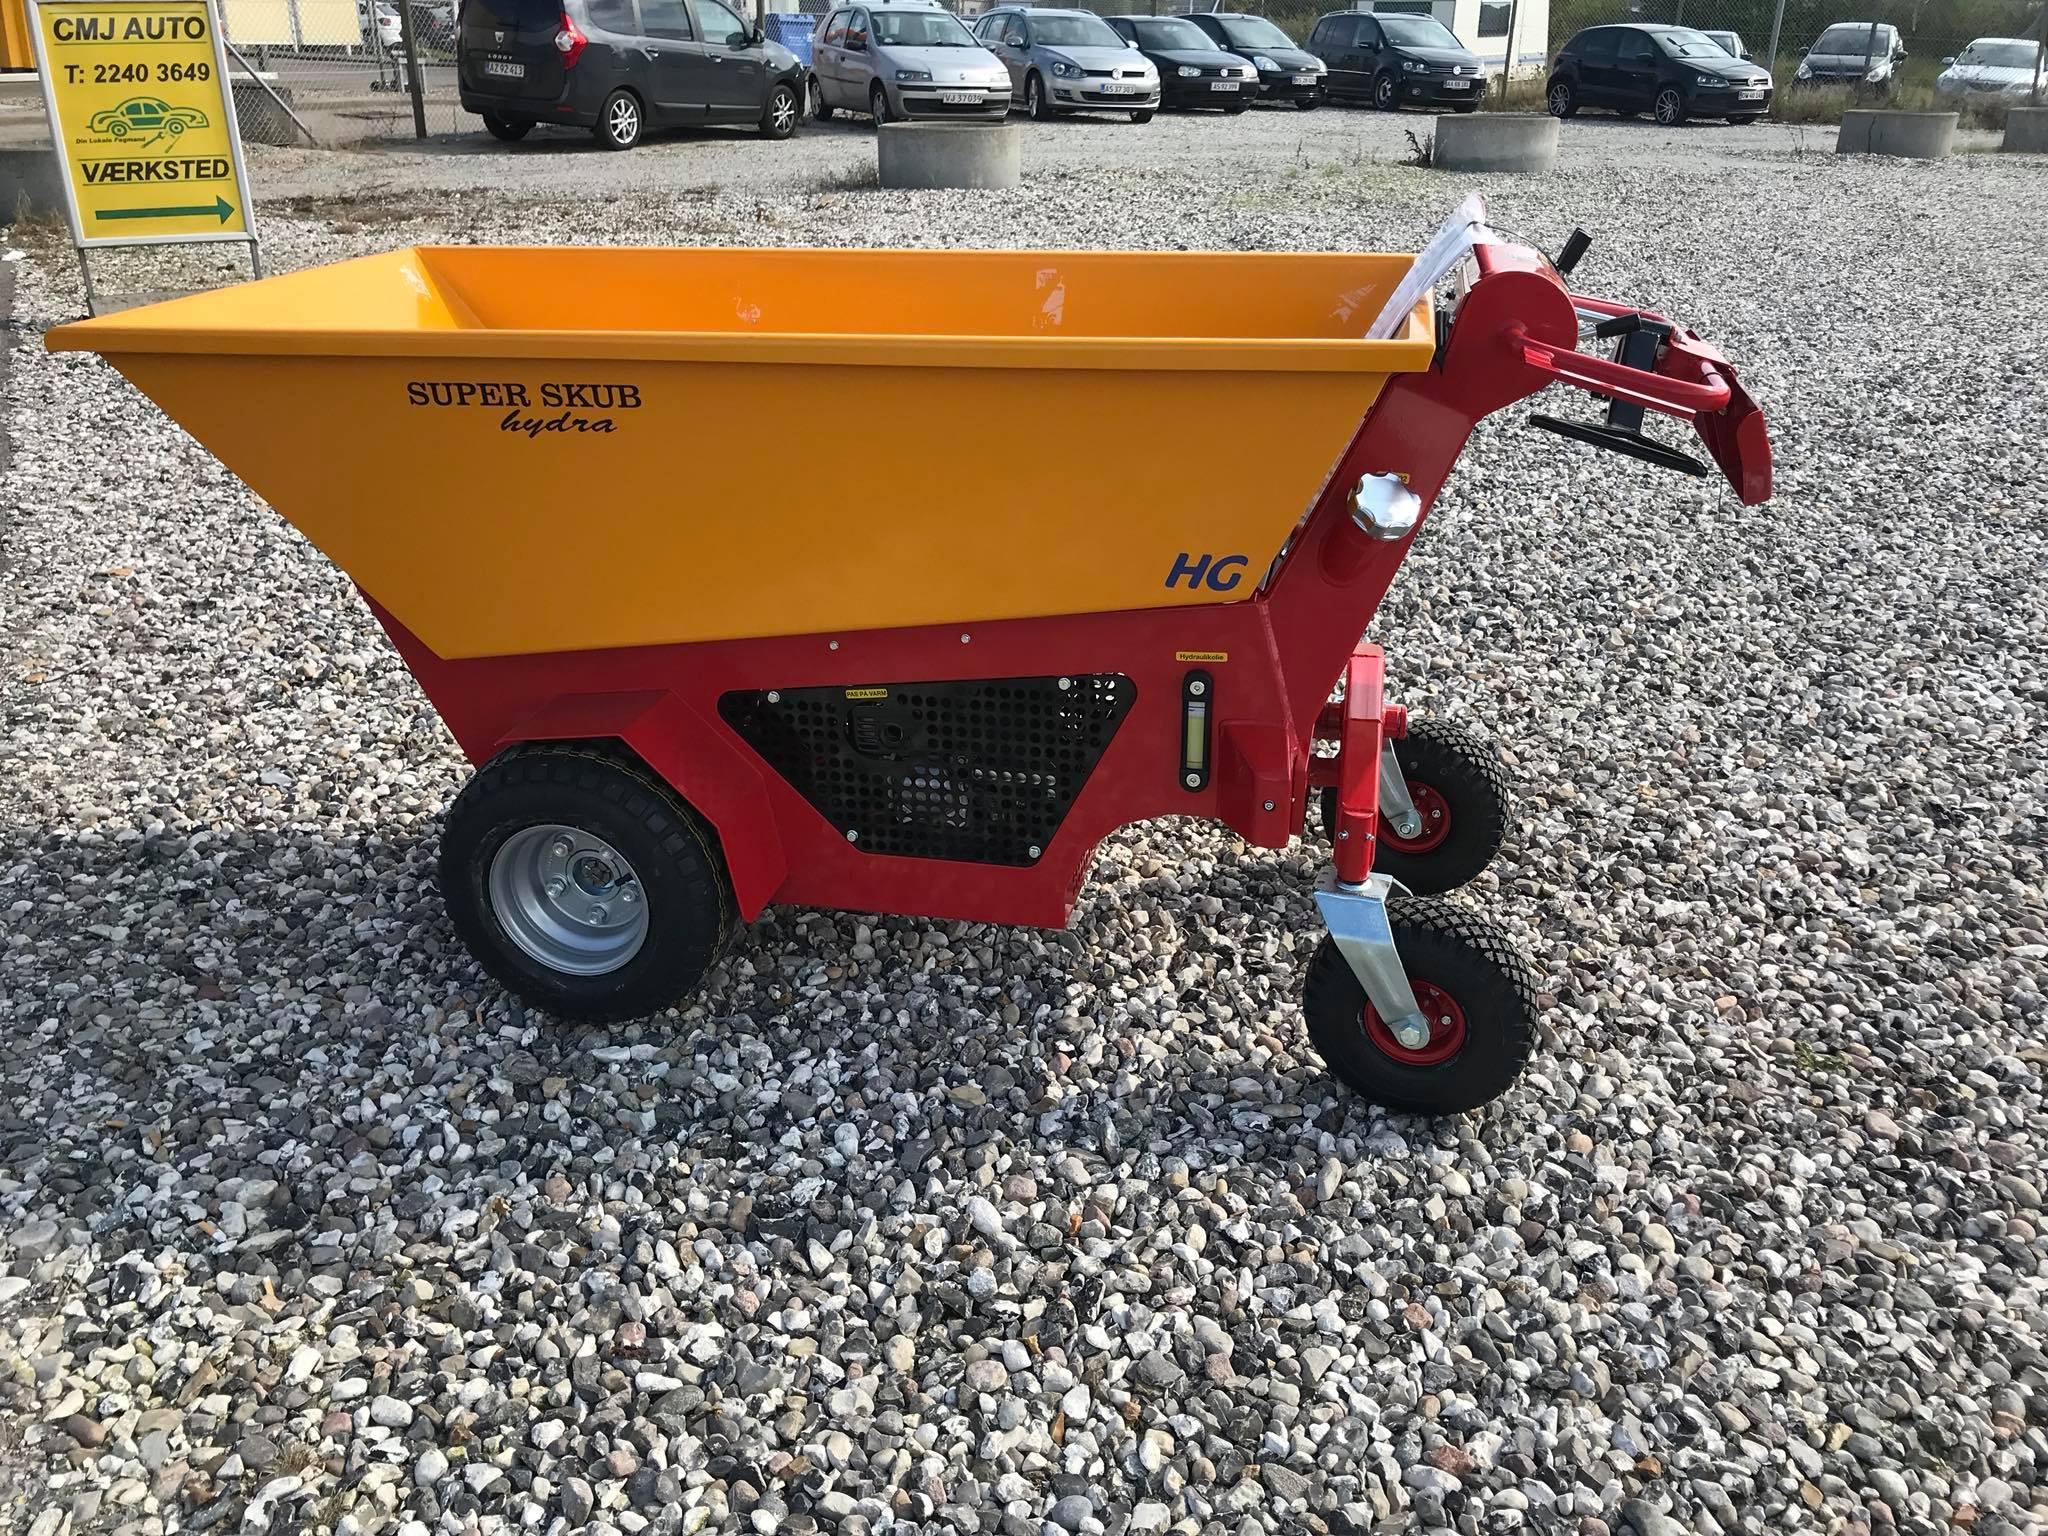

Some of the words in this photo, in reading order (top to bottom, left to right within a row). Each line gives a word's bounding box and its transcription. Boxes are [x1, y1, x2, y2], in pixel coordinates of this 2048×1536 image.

[53, 17, 116, 41] CMJ
[123, 16, 205, 41] AUTO
[64, 64, 84, 84] T:
[94, 63, 148, 83] 2240
[157, 62, 210, 82] 3649
[81, 159, 230, 182] VÆRKSTED
[407, 382, 531, 407] SUPER
[540, 383, 642, 408] SKUB
[501, 409, 618, 438] hydra
[1165, 553, 1249, 591] HG
